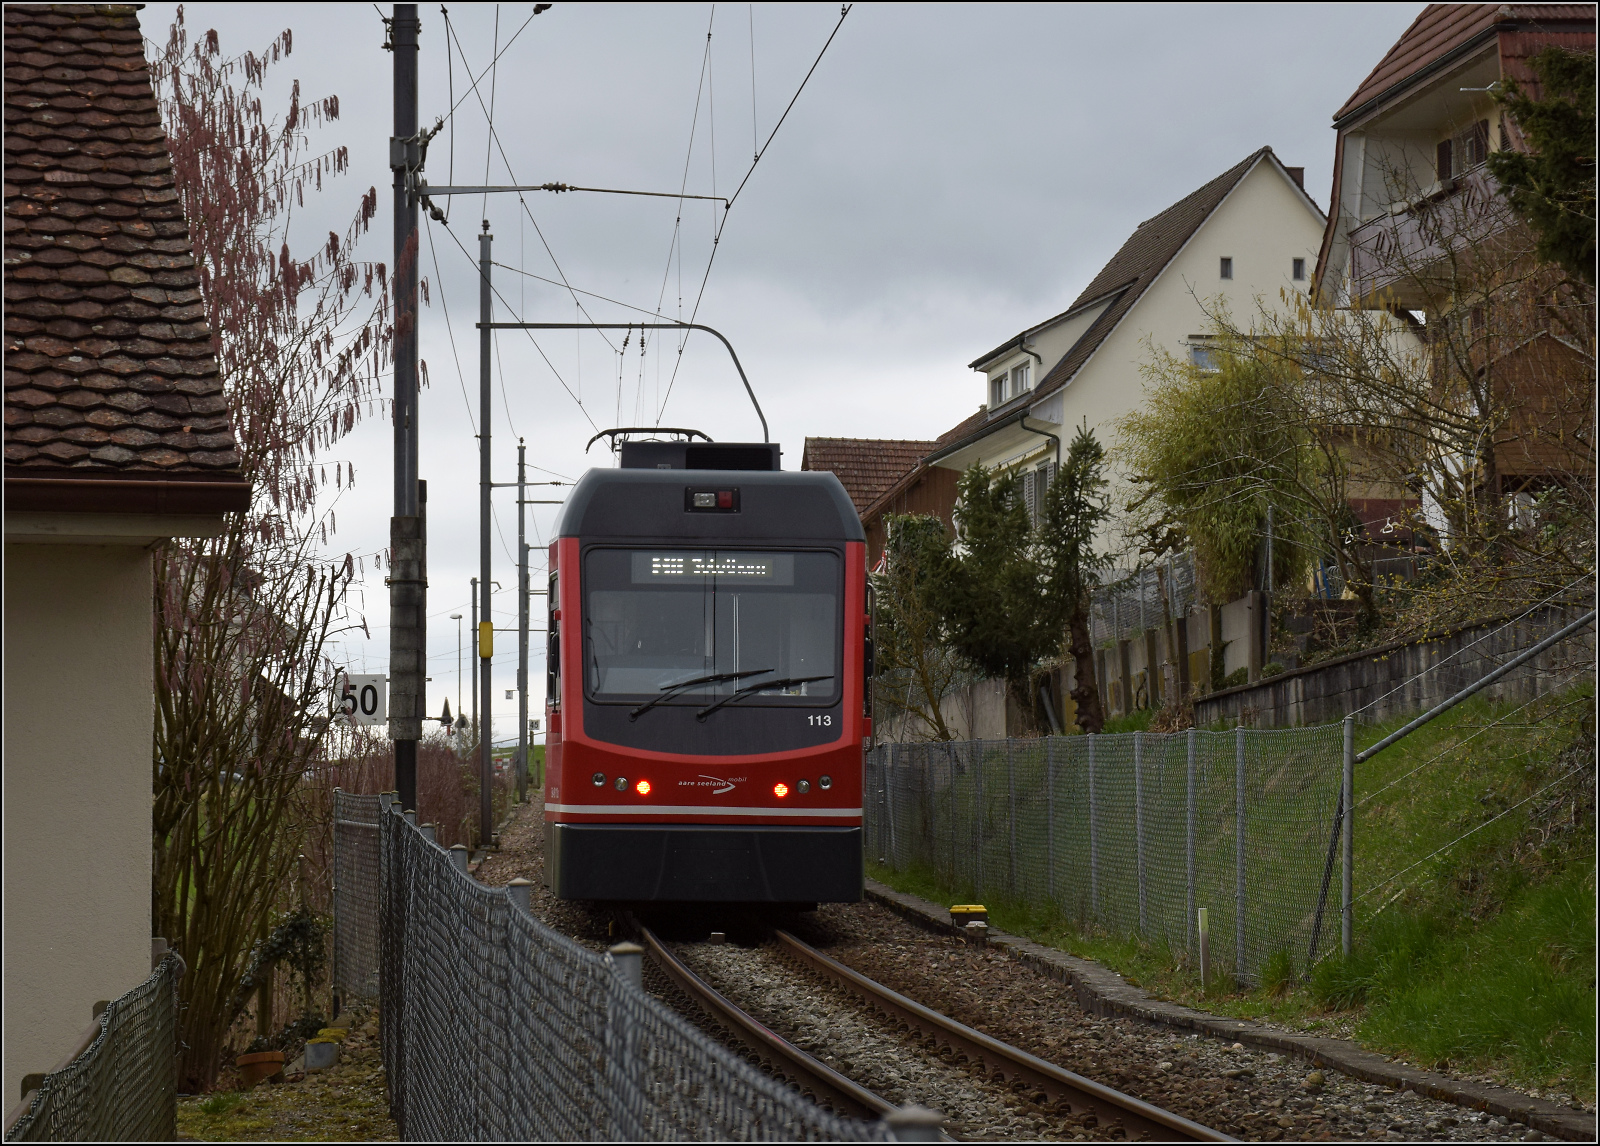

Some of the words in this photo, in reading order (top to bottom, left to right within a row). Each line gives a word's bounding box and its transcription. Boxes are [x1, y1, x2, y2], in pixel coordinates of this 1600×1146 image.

[340, 684, 378, 716] 50
[529, 721, 539, 729] 45
[807, 714, 832, 726] 113
